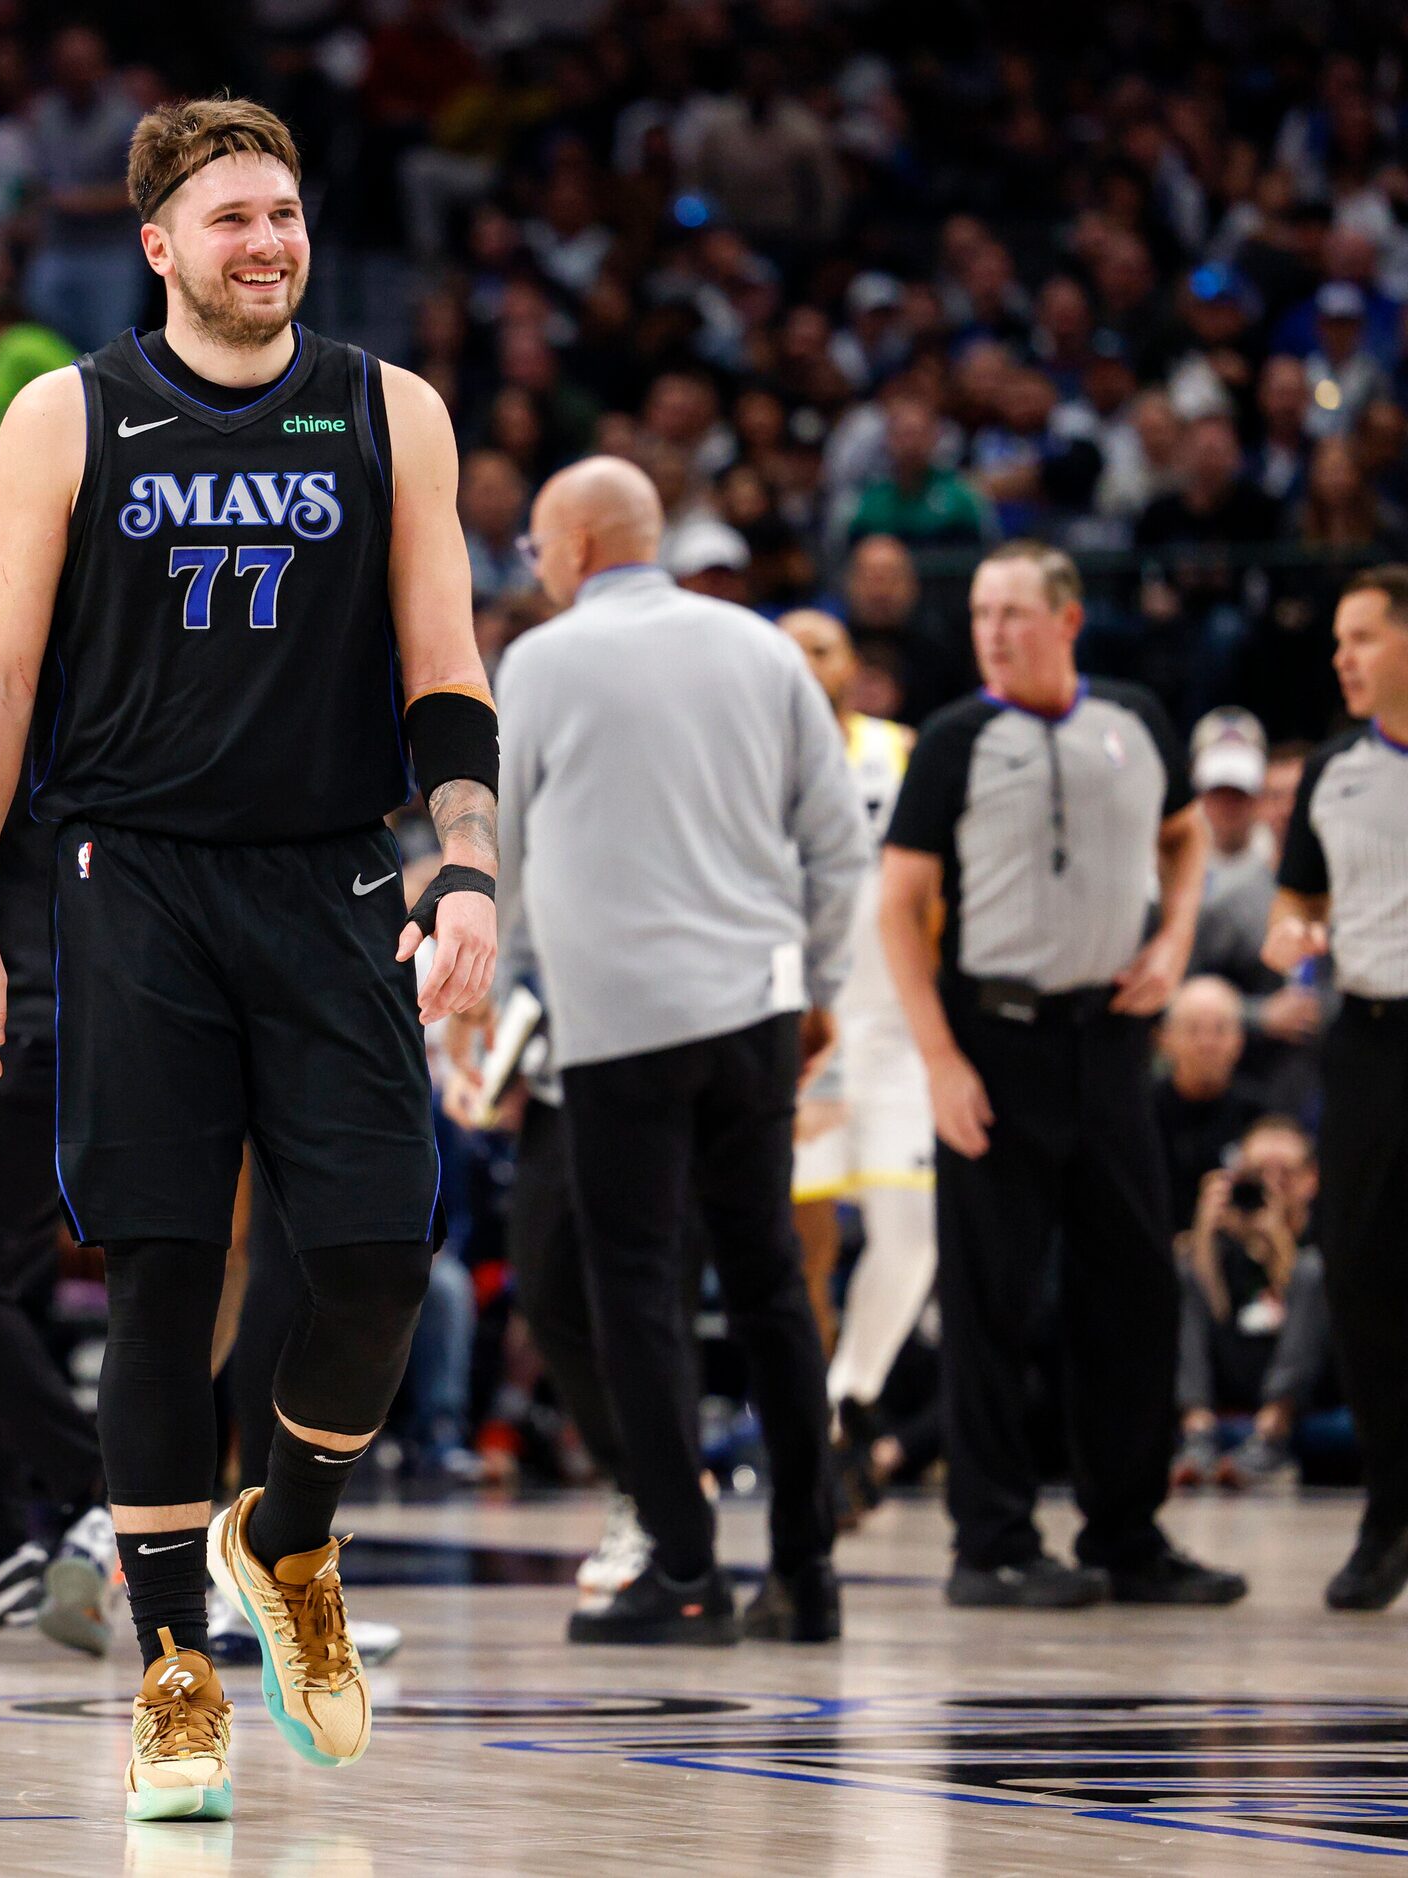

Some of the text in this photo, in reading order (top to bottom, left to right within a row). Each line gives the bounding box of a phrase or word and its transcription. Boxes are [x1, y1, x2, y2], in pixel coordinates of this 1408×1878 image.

[282, 415, 346, 433] chime
[118, 471, 343, 541] MAVS
[169, 545, 294, 630] 77
